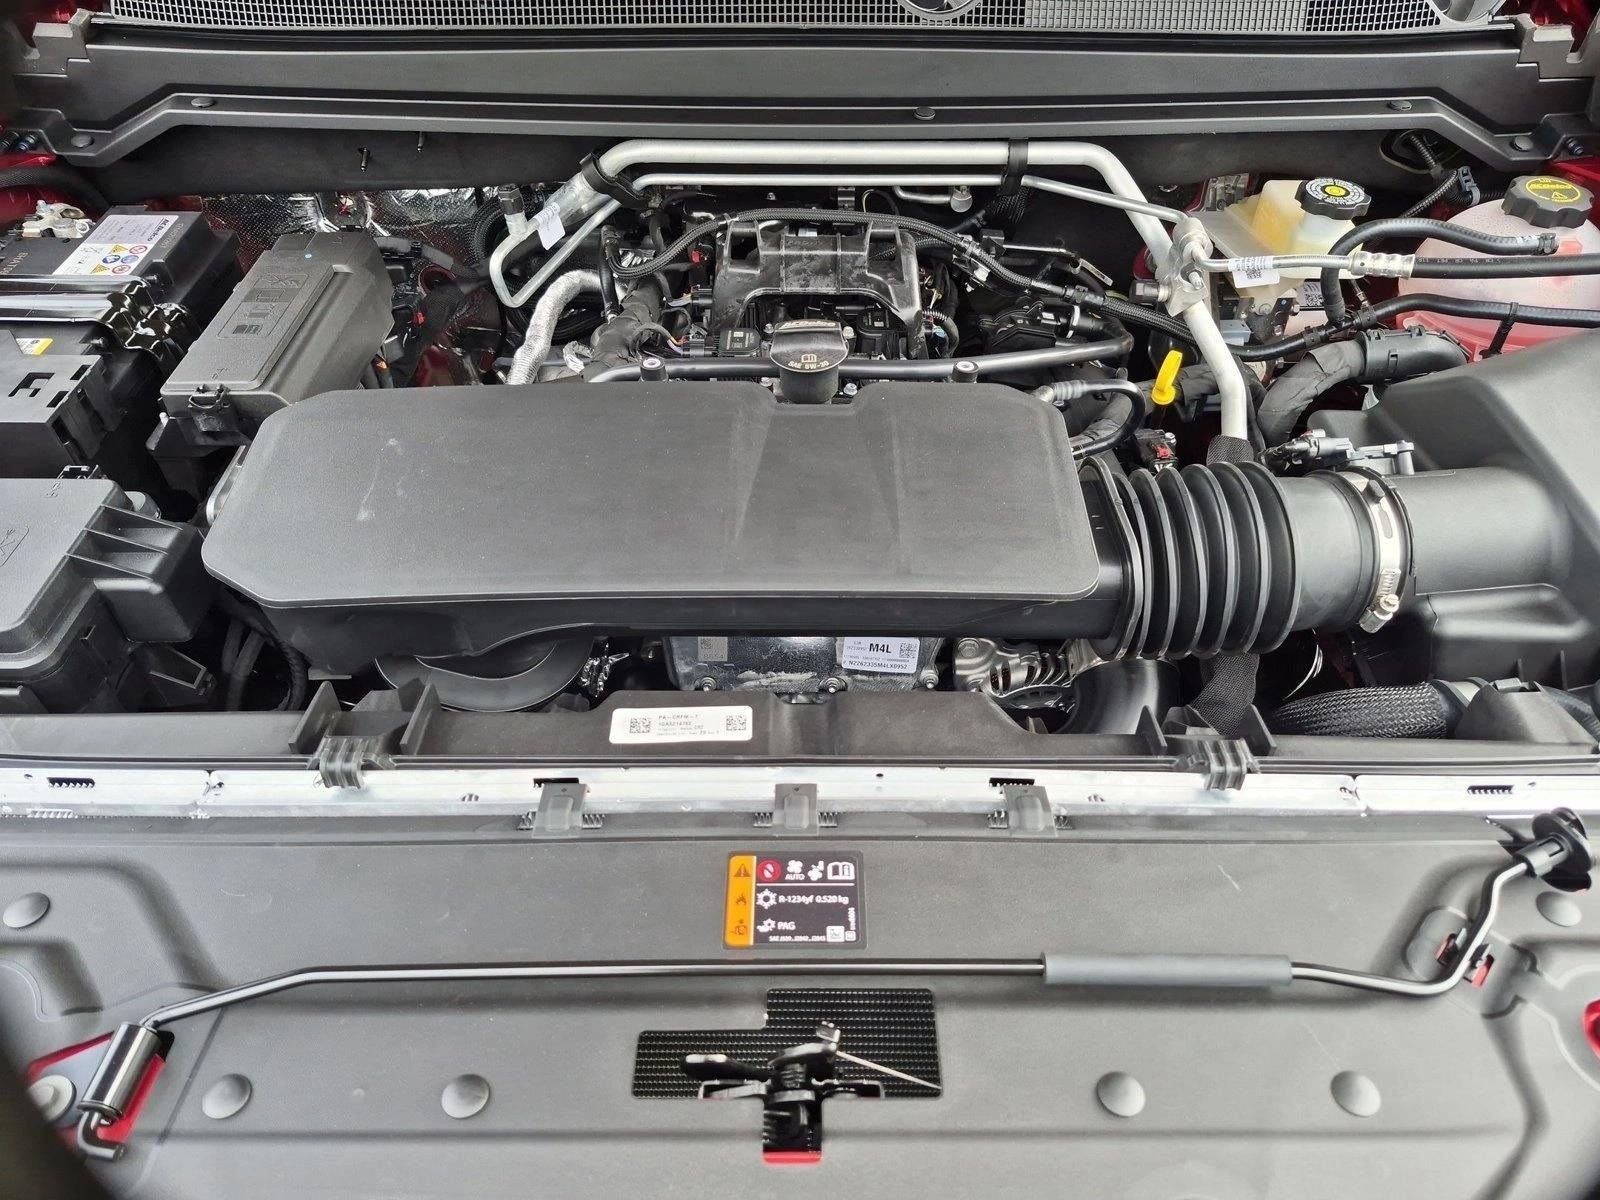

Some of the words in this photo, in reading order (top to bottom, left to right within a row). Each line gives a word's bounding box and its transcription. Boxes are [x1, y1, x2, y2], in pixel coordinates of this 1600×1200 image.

[869, 643, 891, 654] M4L
[779, 894, 815, 905] R-1234yf
[815, 895, 837, 904] 0.520
[838, 895, 849, 905] kg
[777, 921, 796, 931] PAG
